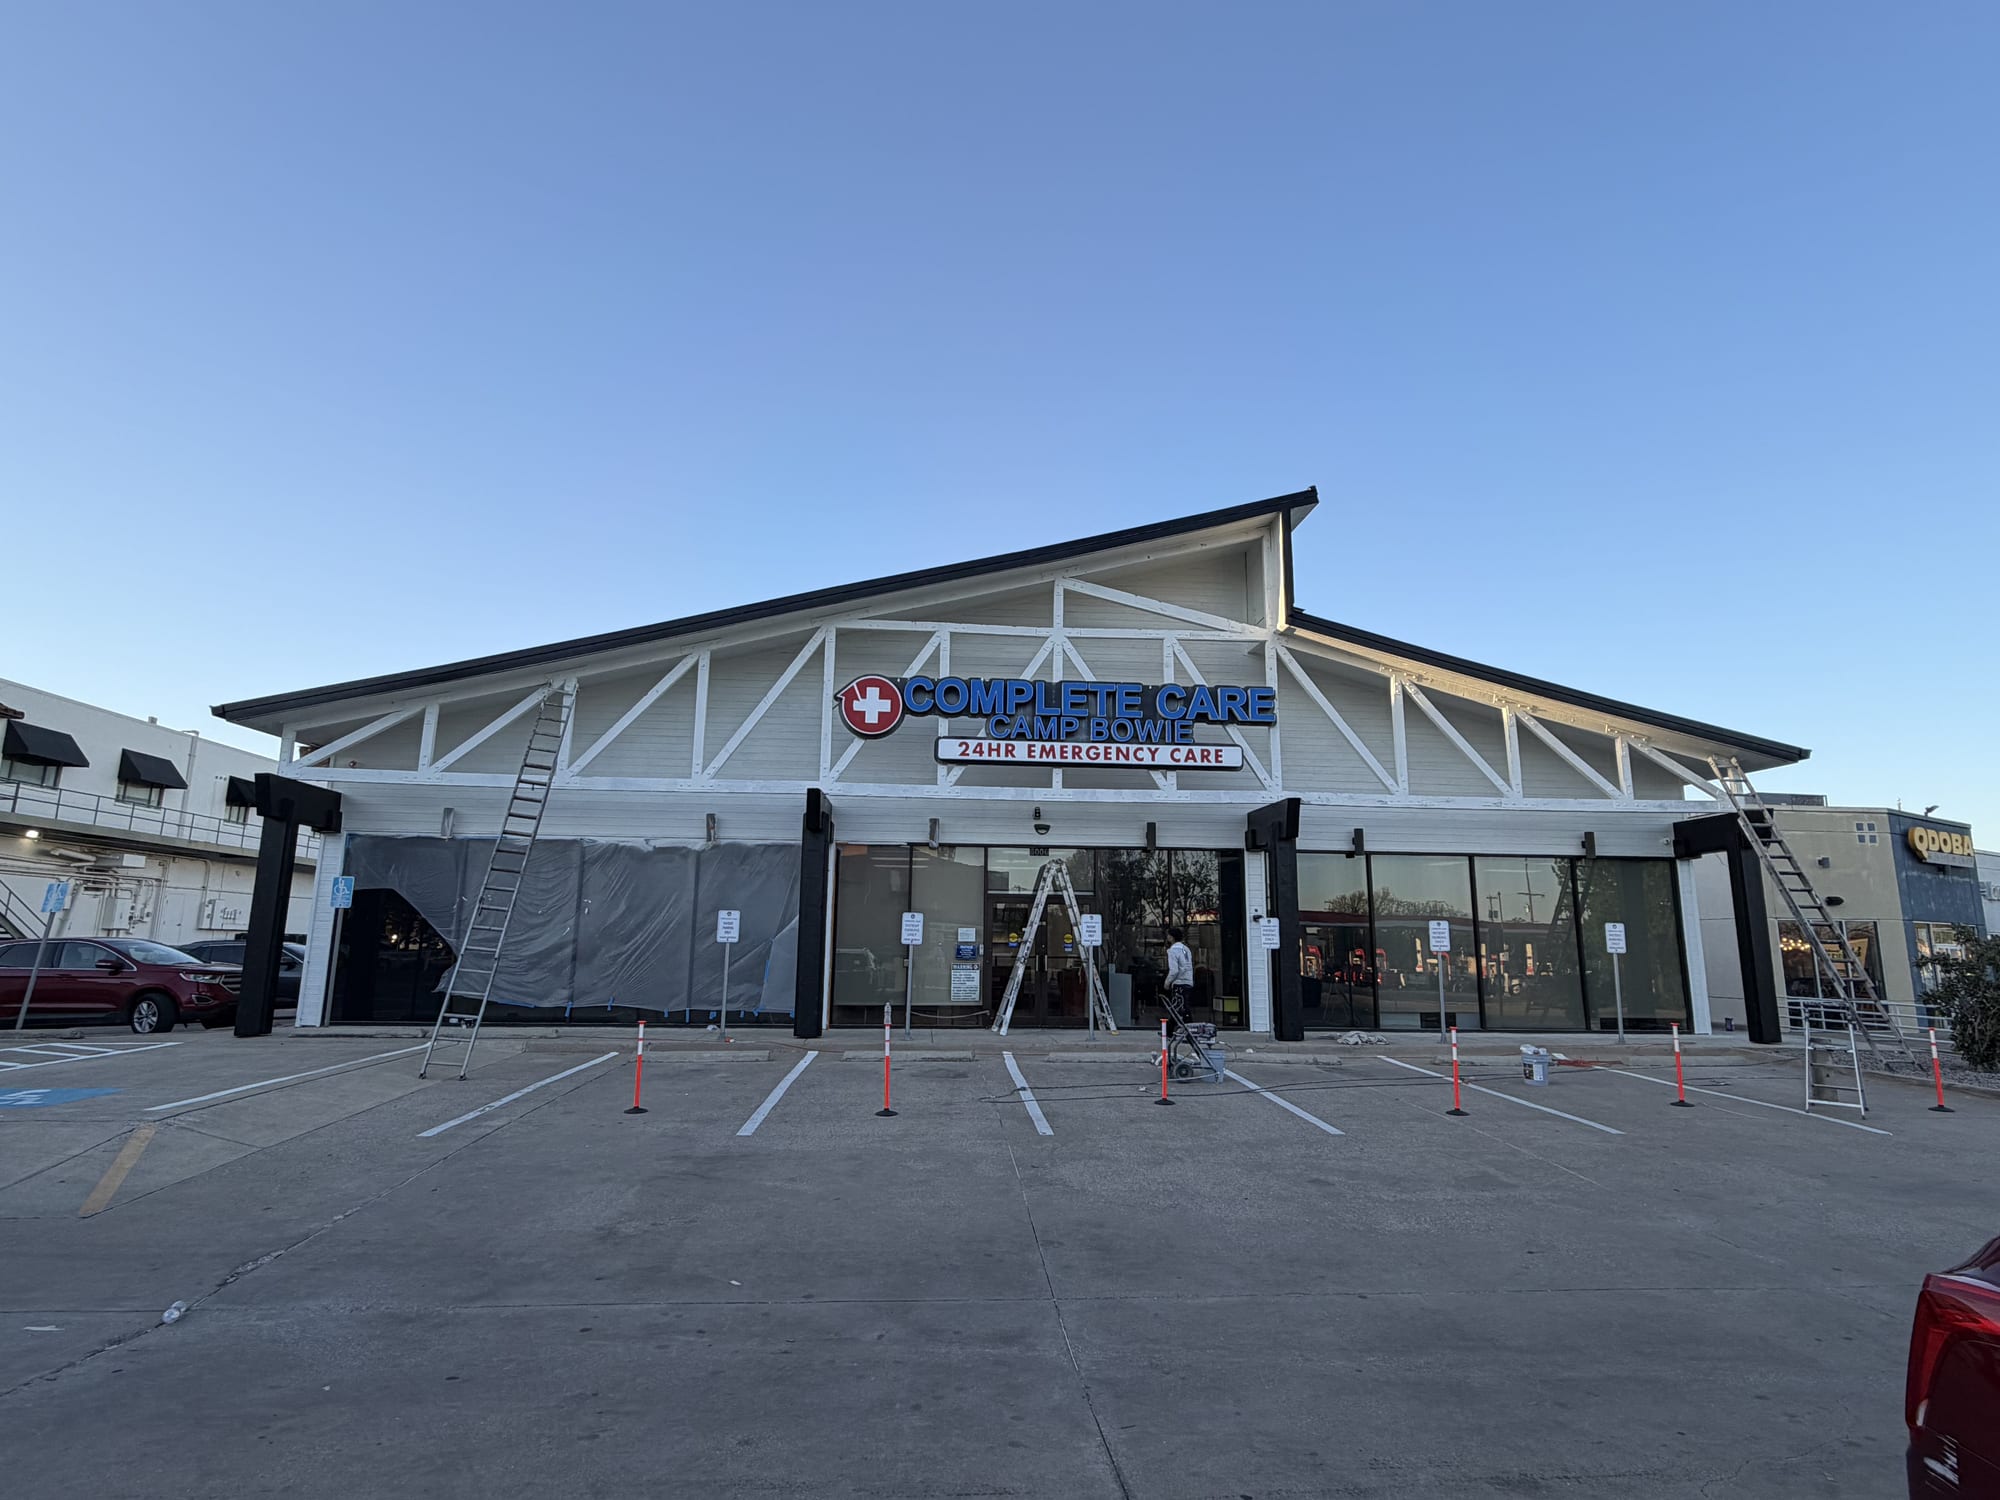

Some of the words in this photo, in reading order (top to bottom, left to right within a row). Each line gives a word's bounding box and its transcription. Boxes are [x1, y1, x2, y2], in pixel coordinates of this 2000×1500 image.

[903, 676, 1144, 718] COMPLETE
[1156, 684, 1277, 723] CARE
[988, 714, 1080, 741] CAMP
[1090, 717, 1194, 744] BOWIE
[958, 741, 1017, 758] 24HR
[1027, 743, 1160, 763] EMERGENCY
[1170, 748, 1224, 764] CARE
[1909, 827, 1974, 860] QDOBA
